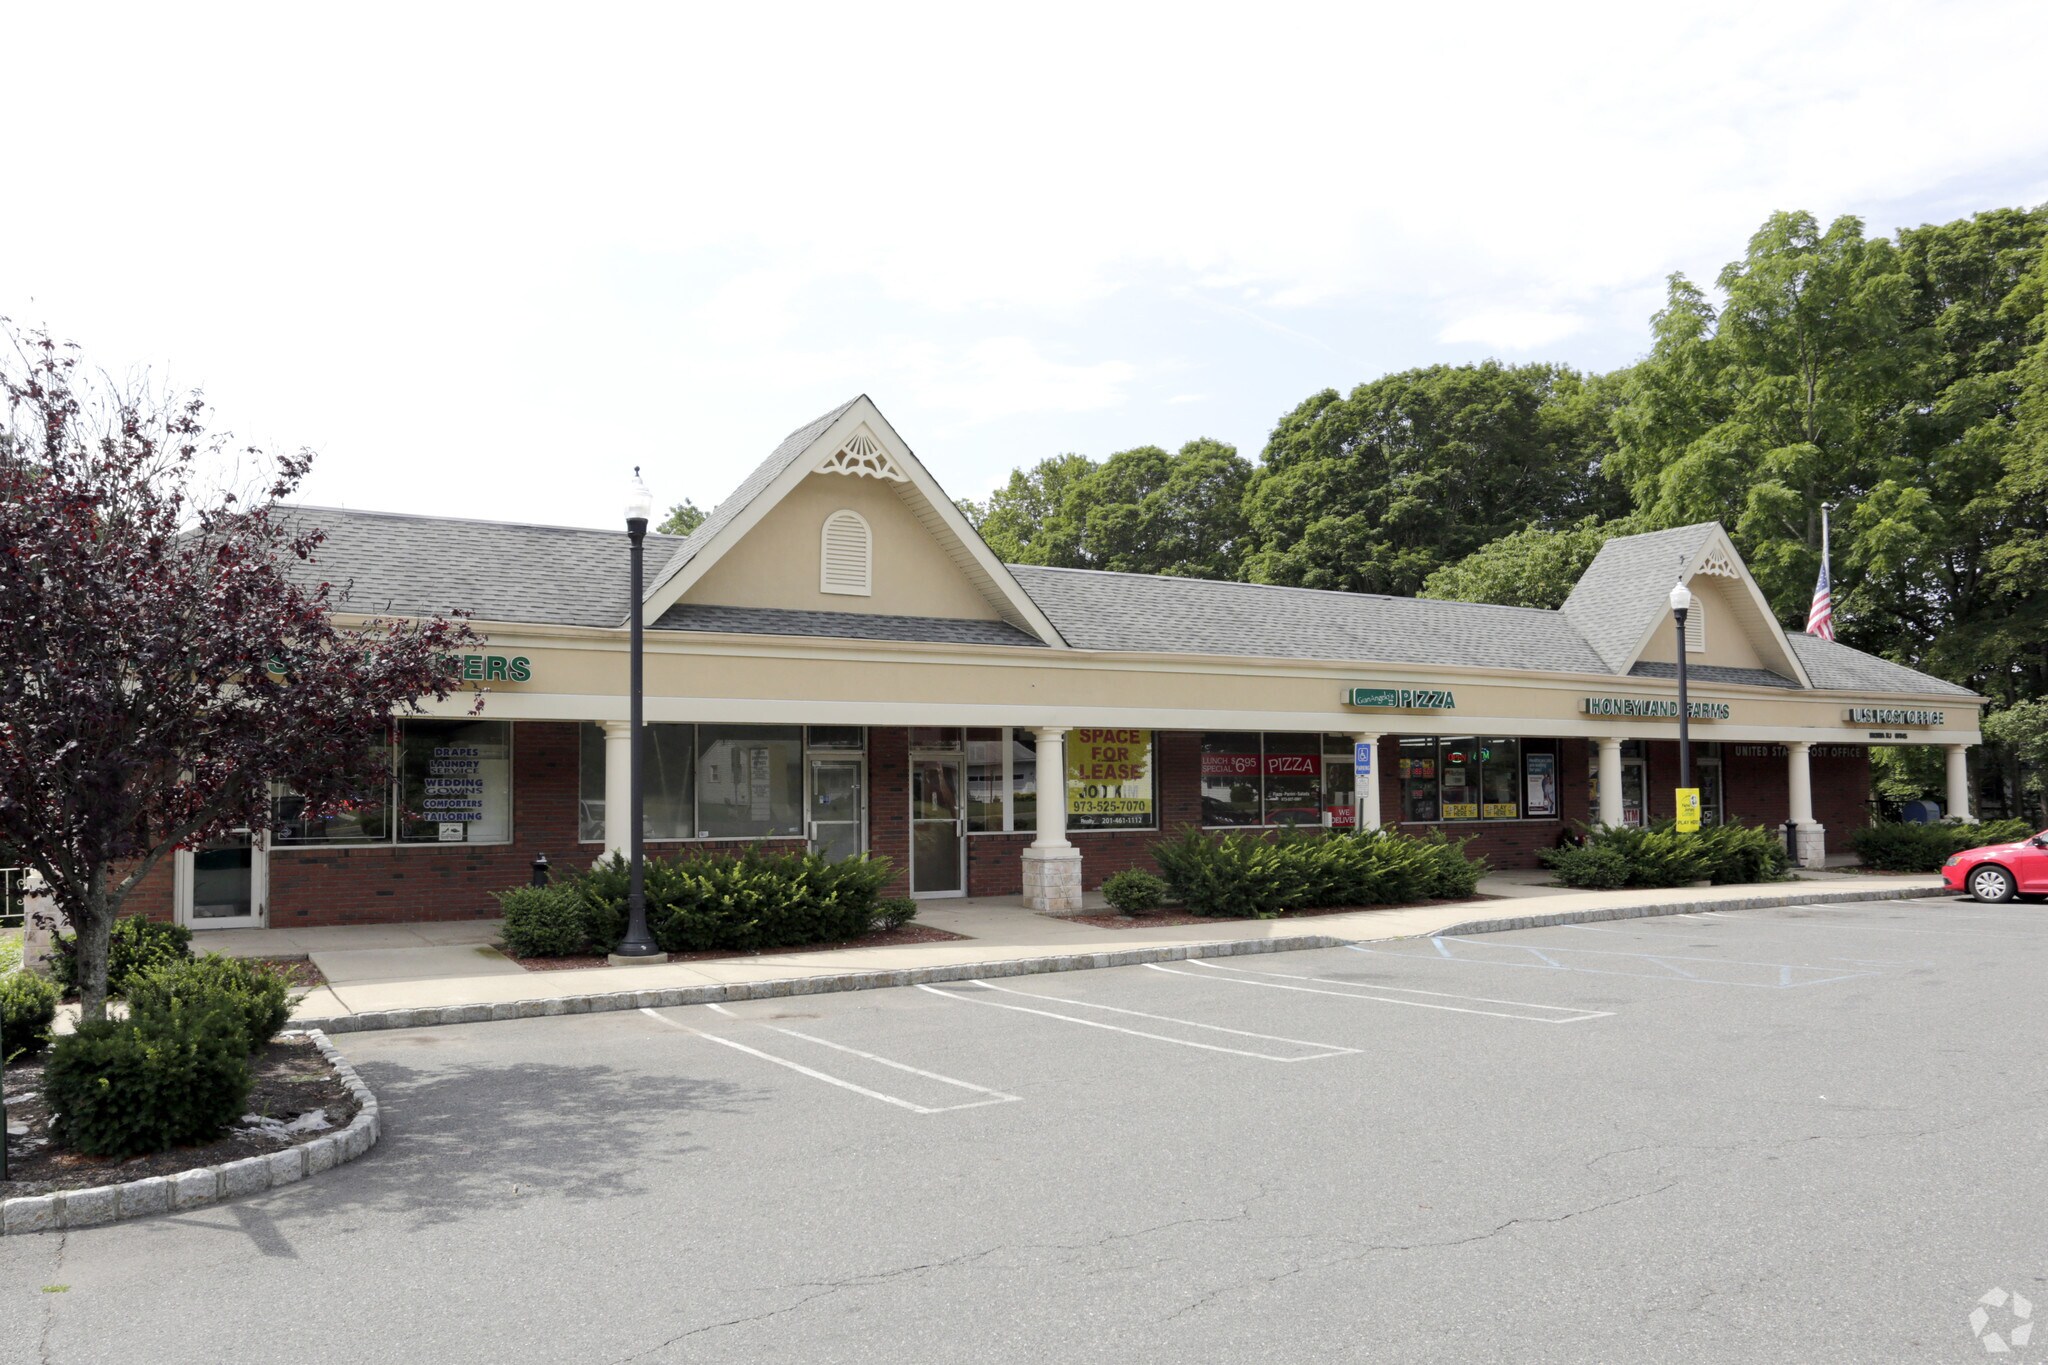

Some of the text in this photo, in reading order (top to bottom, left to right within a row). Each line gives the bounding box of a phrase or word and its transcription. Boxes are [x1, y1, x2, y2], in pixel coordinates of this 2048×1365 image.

[1400, 689, 1456, 709] PIZZA
[1589, 697, 1730, 720] HONEYLAND FARMS
[1877, 709, 1907, 724] POST
[1907, 710, 1945, 725] OFFICE
[1079, 729, 1141, 744] SPACE
[435, 748, 479, 757] DRAPES
[1091, 747, 1129, 760] FOR
[1735, 745, 1768, 757] UNITED
[1831, 747, 1860, 758] OFFICE
[430, 760, 480, 768] LAUNDRY
[1202, 757, 1228, 765] LUNCH
[1268, 757, 1314, 773] PIZZA
[1079, 764, 1143, 780] LEASE
[1202, 765, 1233, 773] SPECIAL
[425, 779, 483, 787] WEDDING
[424, 787, 483, 795] GOWNS
[423, 800, 483, 808] COMFORTERS
[1073, 800, 1146, 812] 973-525-7070
[423, 812, 483, 821] TAILORING
[1623, 809, 1639, 822] ATM
